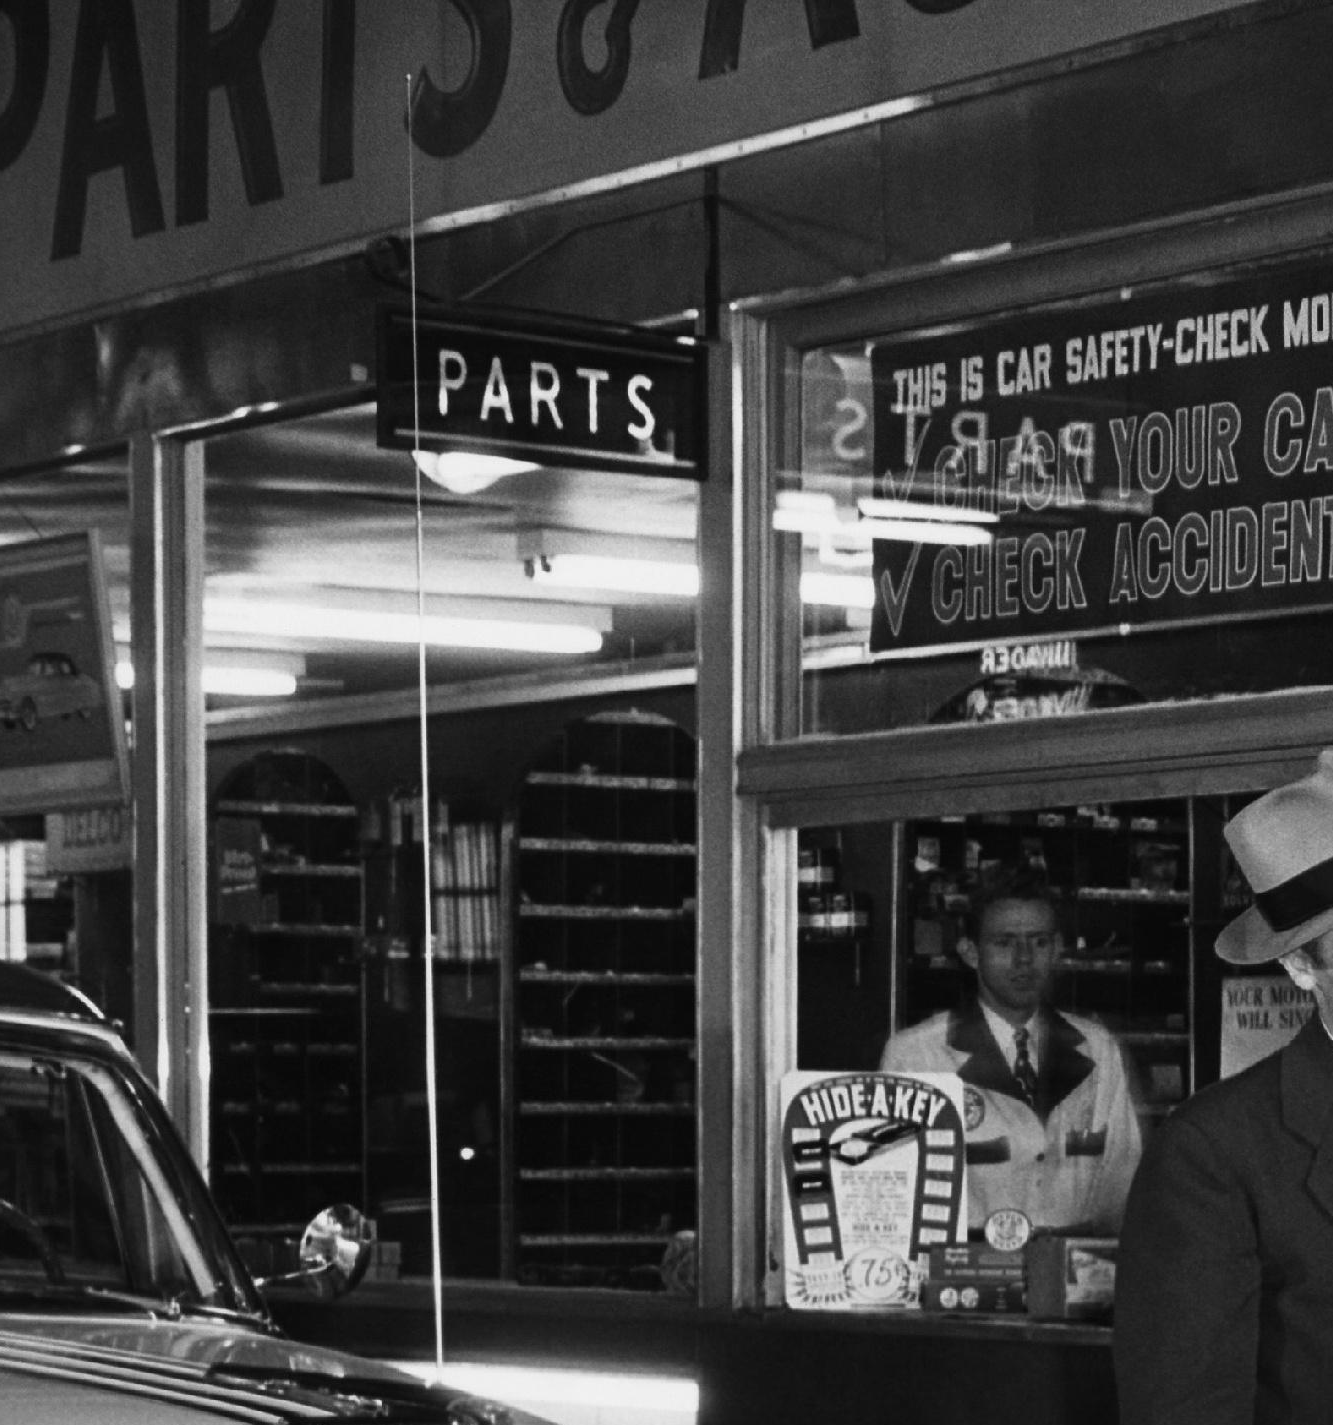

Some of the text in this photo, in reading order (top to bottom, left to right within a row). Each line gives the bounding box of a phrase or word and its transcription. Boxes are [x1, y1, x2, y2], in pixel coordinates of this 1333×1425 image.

[438, 349, 658, 443] PARTS
[892, 362, 947, 411] THIS
[960, 357, 984, 402] IS
[997, 343, 1051, 397] CAR
[1065, 303, 1270, 384] SAFETY-CHECK
[932, 426, 1086, 520] CHECK
[1108, 401, 1241, 498] YOUR
[931, 527, 1087, 624] CHECK
